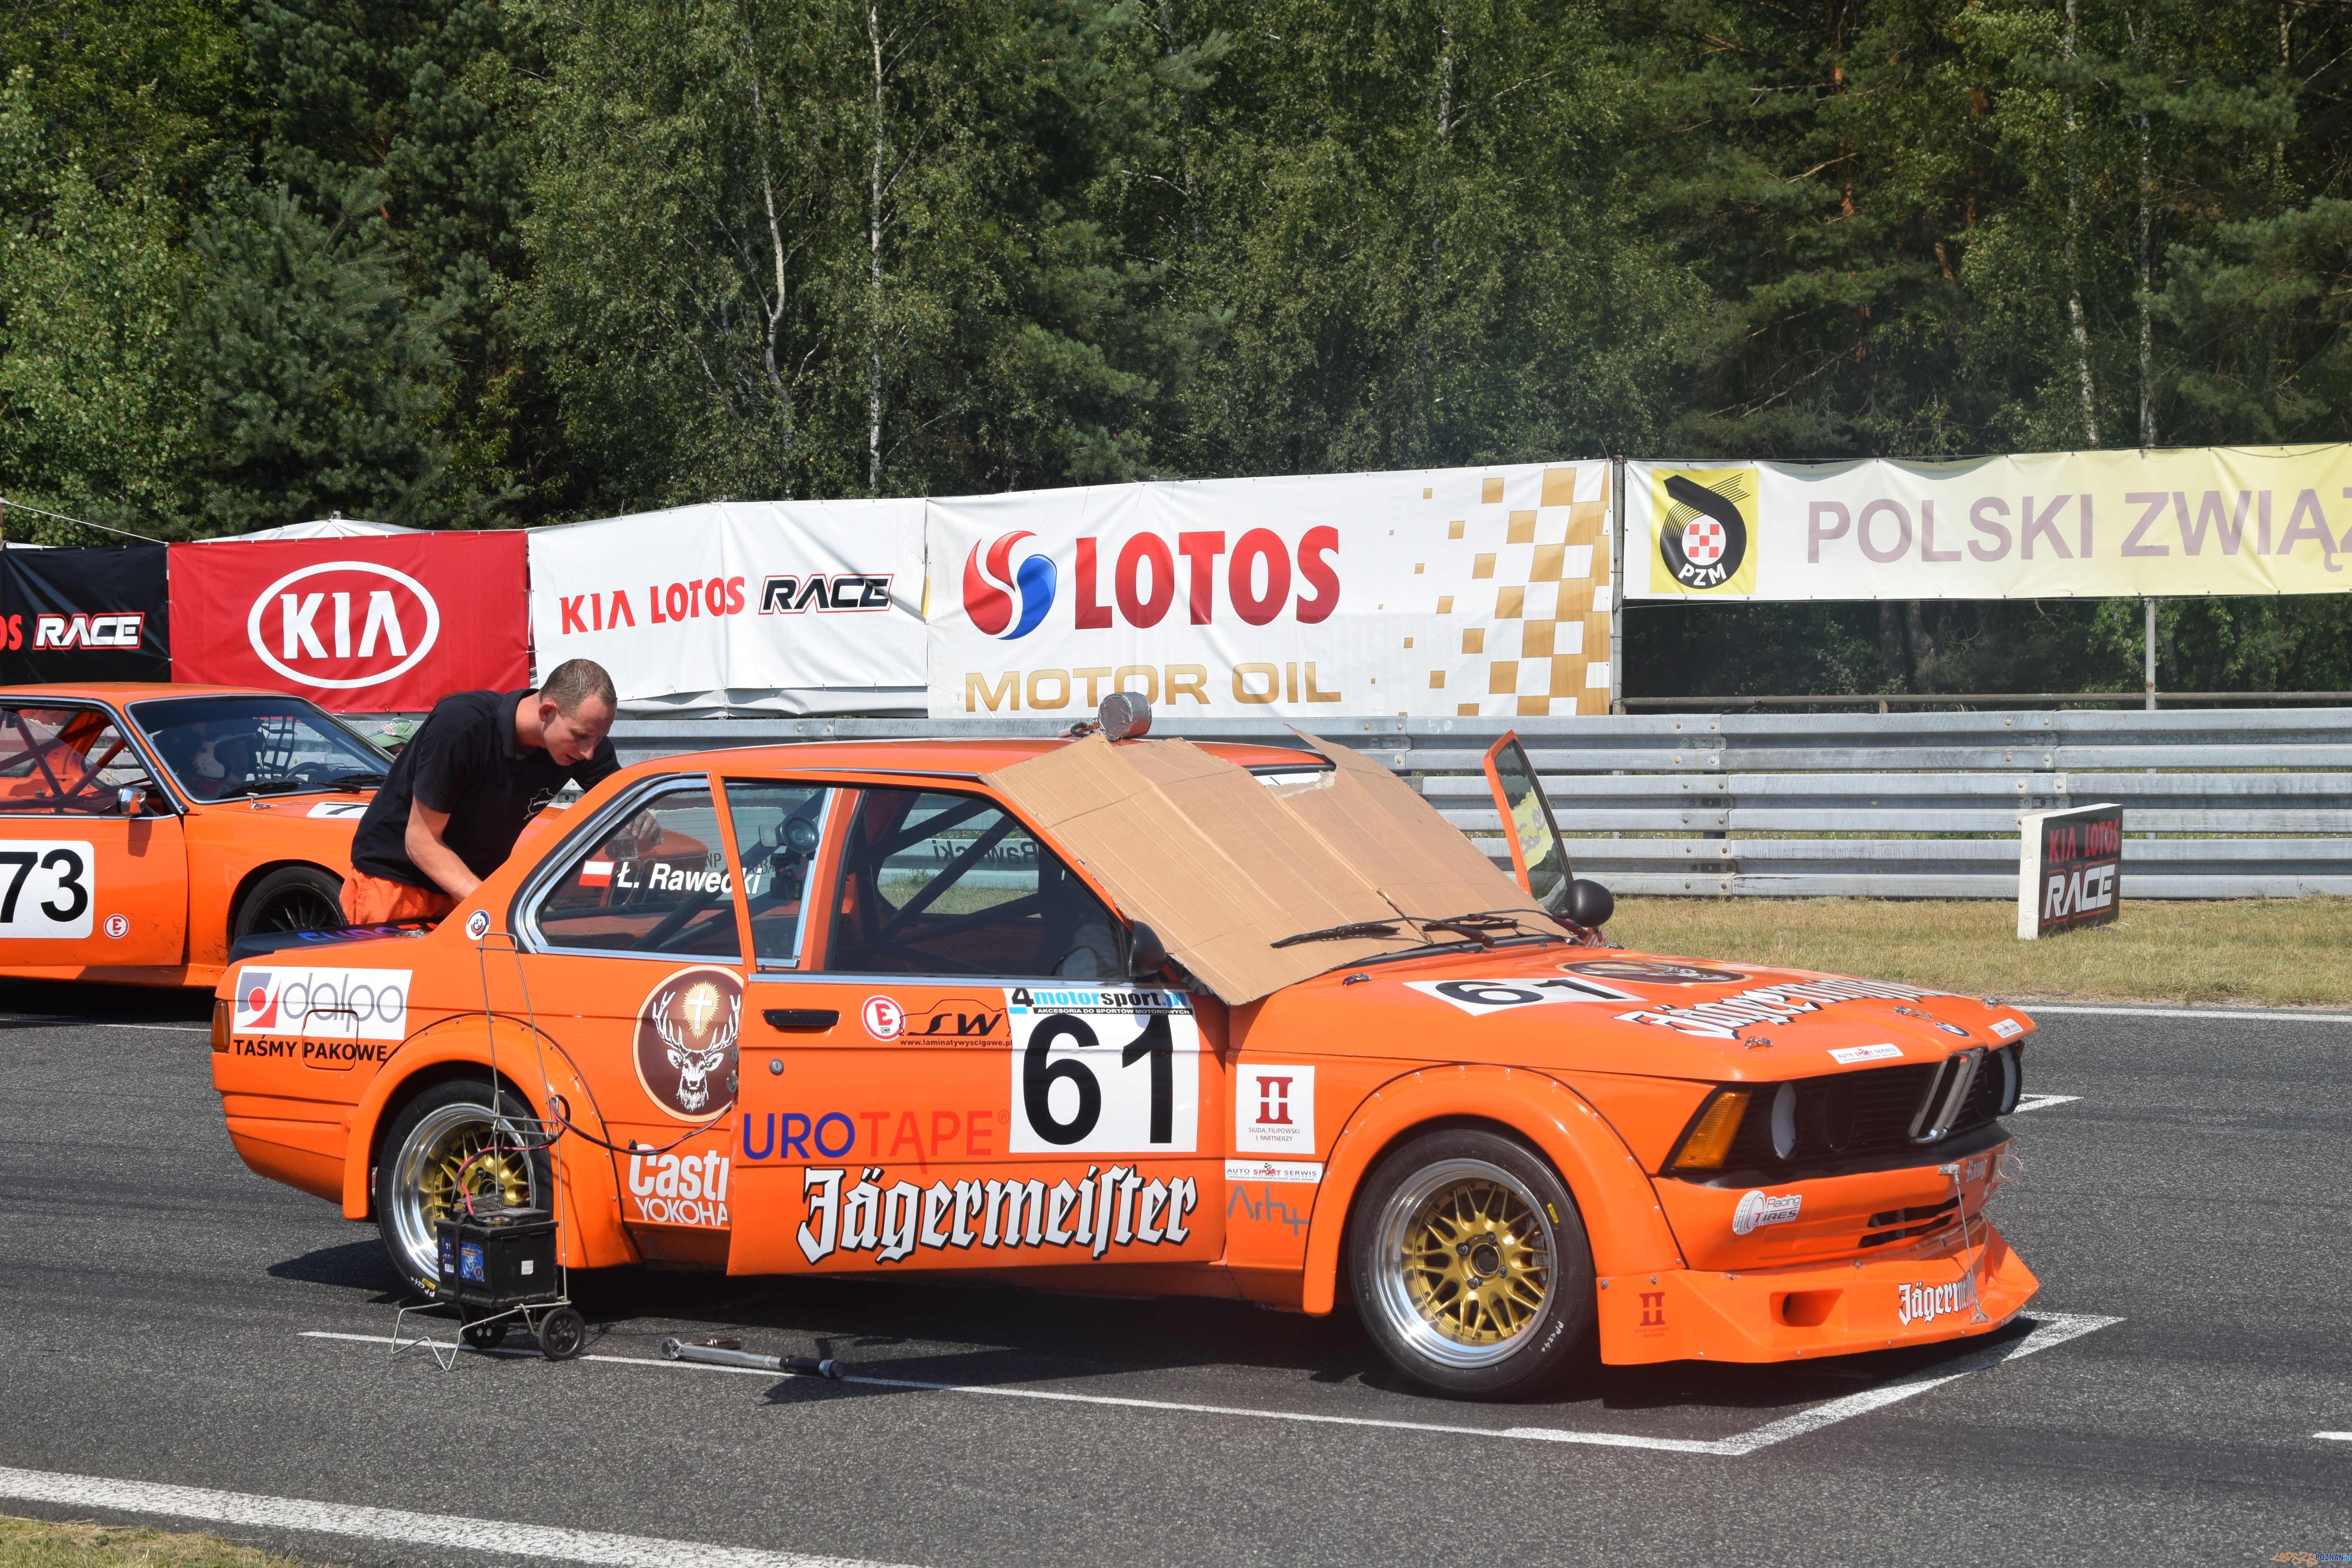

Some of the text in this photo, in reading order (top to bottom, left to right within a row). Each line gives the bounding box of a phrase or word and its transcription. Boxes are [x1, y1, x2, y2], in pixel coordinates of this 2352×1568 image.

[1808, 487, 2352, 573] POLSKI ZWIĄ
[1075, 525, 1340, 629] LOTOS
[1677, 563, 1727, 586] PZM
[281, 590, 407, 659] KIA
[559, 574, 892, 635] KIA LOTOS RACE
[34, 613, 143, 649] RACE
[965, 661, 1341, 713] MOTOR OIL
[2049, 819, 2120, 864] KIA LOTOS
[0, 848, 88, 922] 73
[617, 862, 639, 888] Ł.
[2043, 861, 2117, 922] RACE
[283, 972, 404, 1032] dalpo
[1435, 978, 1628, 1005] 61
[233, 1034, 387, 1062] TAŚMY PAKOWE
[900, 1039, 1012, 1047] www.laminatywyscigowe.pl
[1023, 1014, 1174, 1145] 61
[1767, 1196, 1800, 1209] Racing
